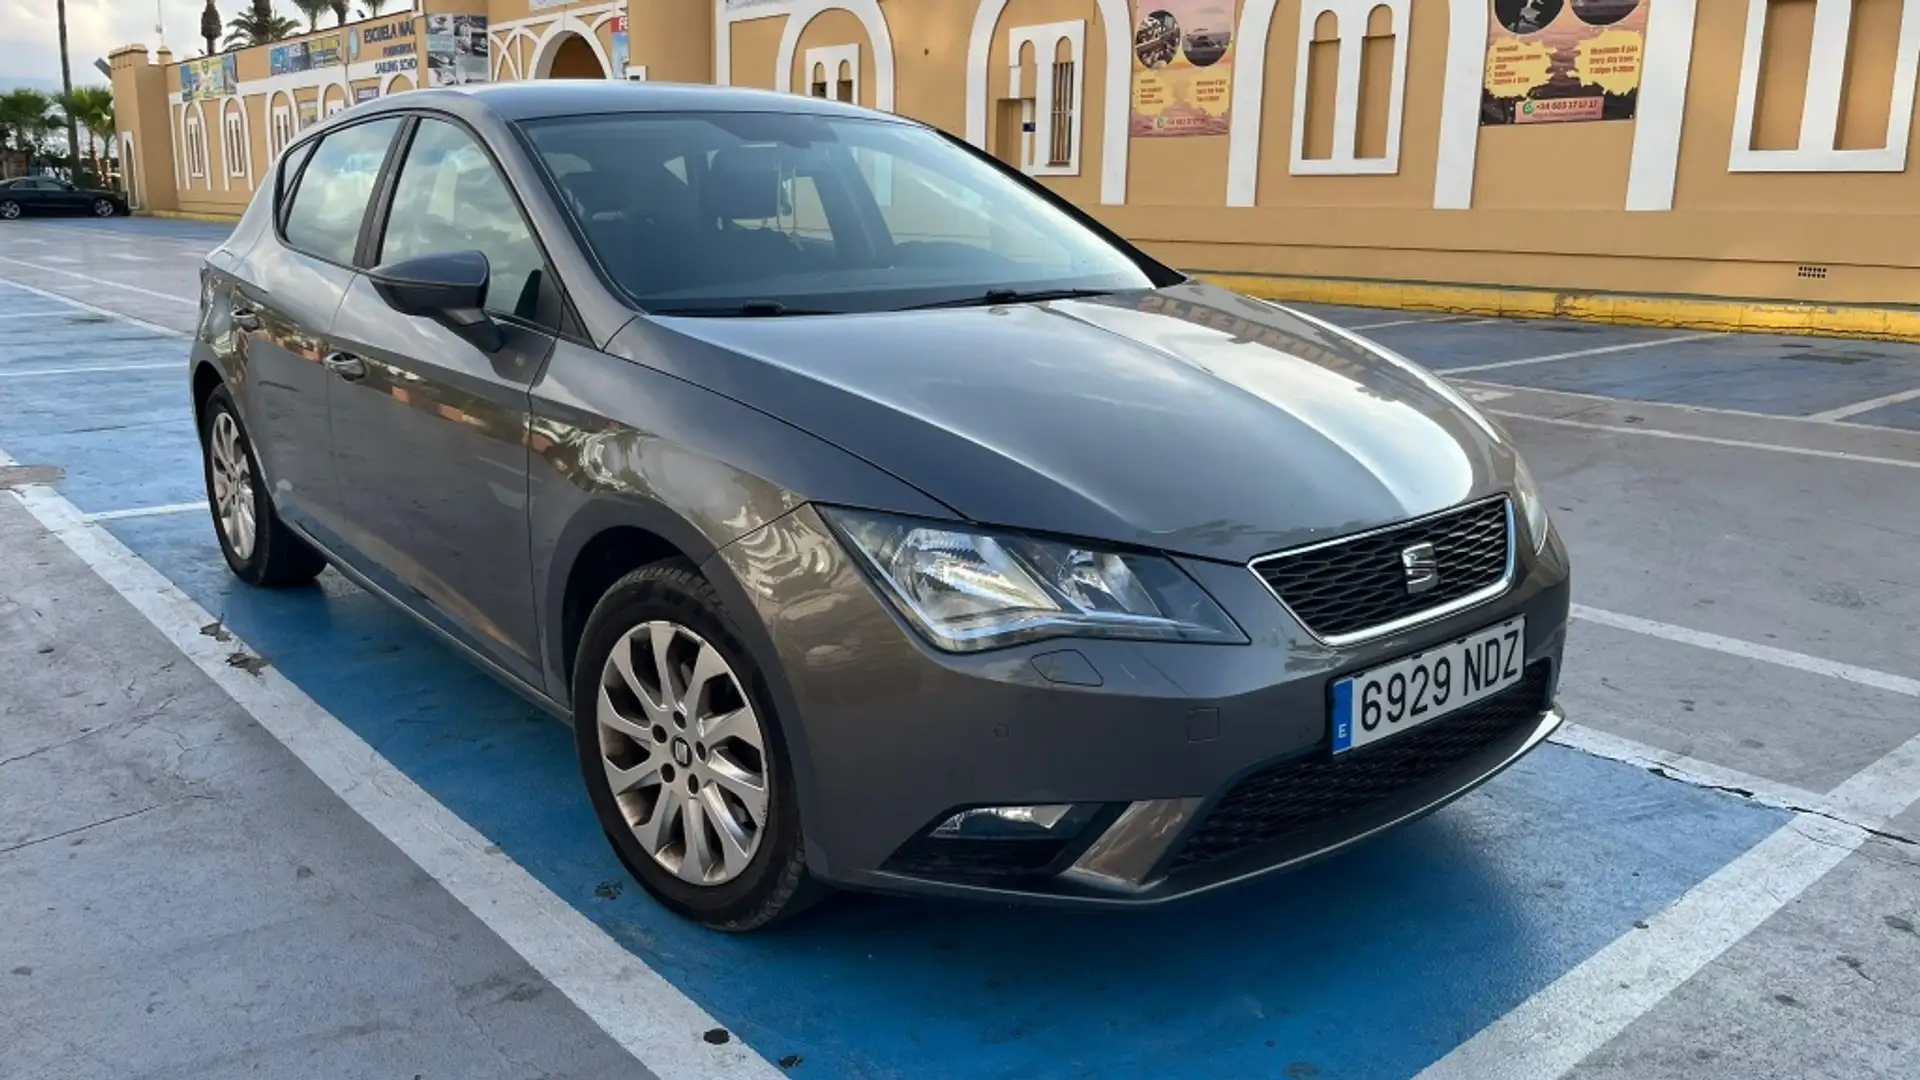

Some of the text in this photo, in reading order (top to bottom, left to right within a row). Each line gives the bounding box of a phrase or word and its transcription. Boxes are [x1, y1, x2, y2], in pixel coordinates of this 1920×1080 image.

[364, 24, 397, 44] ESCUELA
[1361, 628, 1520, 732] 6929 NDZ
[1338, 723, 1348, 739] E
